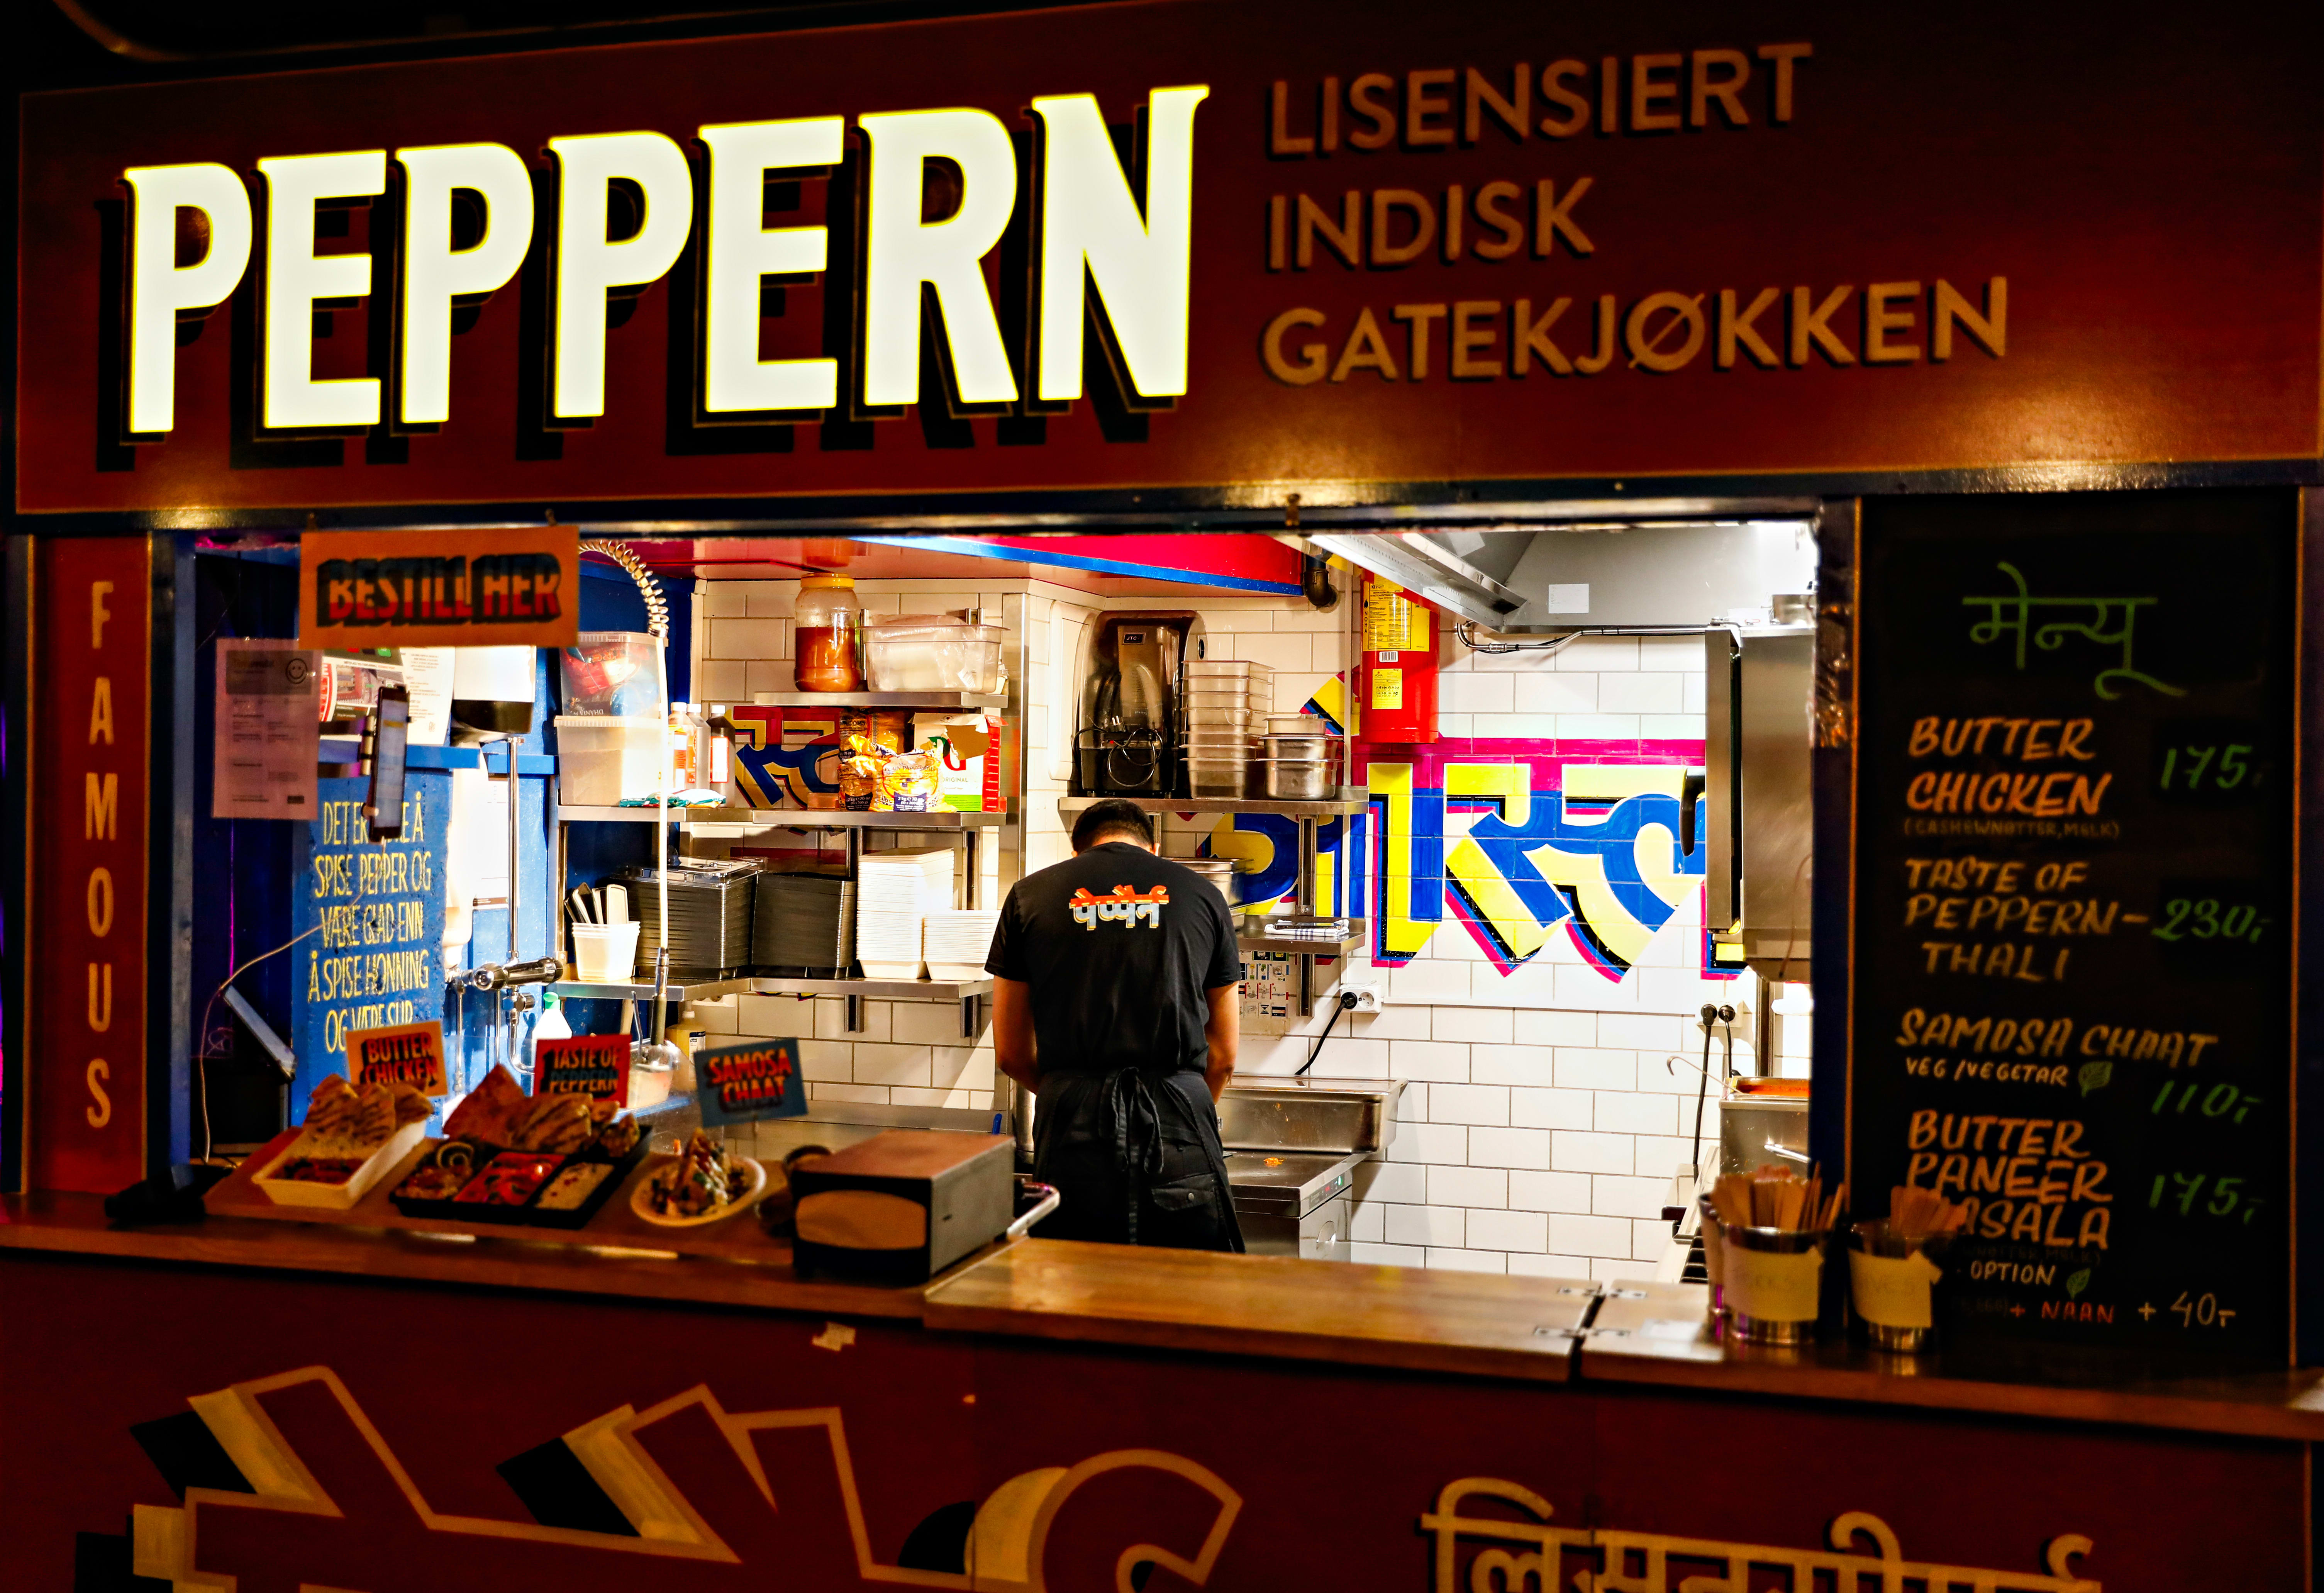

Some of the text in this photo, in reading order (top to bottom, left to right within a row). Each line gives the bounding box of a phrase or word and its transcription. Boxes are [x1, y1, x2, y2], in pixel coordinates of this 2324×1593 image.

[1270, 42, 1812, 154] LISENSIERT
[1268, 176, 1595, 271] INDISK
[124, 83, 1210, 433] PEPPERN
[1262, 275, 2008, 386] GATEKJØKKEN
[324, 554, 561, 621] BESTILL HER
[1908, 716, 2096, 760] BUTTER
[1906, 772, 2112, 816] CHICKEN
[324, 801, 351, 845] DET
[85, 580, 119, 1129] FAMOUS
[315, 850, 432, 898] SPISE PEPPER OG
[1904, 855, 2089, 893] TASTE OF
[320, 905, 361, 948] VÆRE
[398, 901, 424, 942] ENN
[308, 949, 429, 1003] Å SPISE HONNING
[1921, 942, 2071, 982] THALI
[325, 1009, 348, 1053] OG
[363, 1032, 433, 1065] BUTTER
[1896, 1008, 2219, 1068] SAMOSA CHAAT
[361, 1057, 438, 1087] CHICKEN
[551, 1046, 619, 1070] TASTE OF
[707, 1047, 793, 1084] SAMOSA
[1905, 1056, 1947, 1078] VEG
[548, 1069, 619, 1093] PEPPERN
[721, 1075, 786, 1110] CHAAT
[1908, 1109, 2091, 1159] BUTTER
[1905, 1152, 2113, 1205] PANEER
[1957, 1196, 2110, 1250] ASALA
[1970, 1259, 2057, 1287] OPTION
[2041, 1300, 2115, 1325] NAAN
